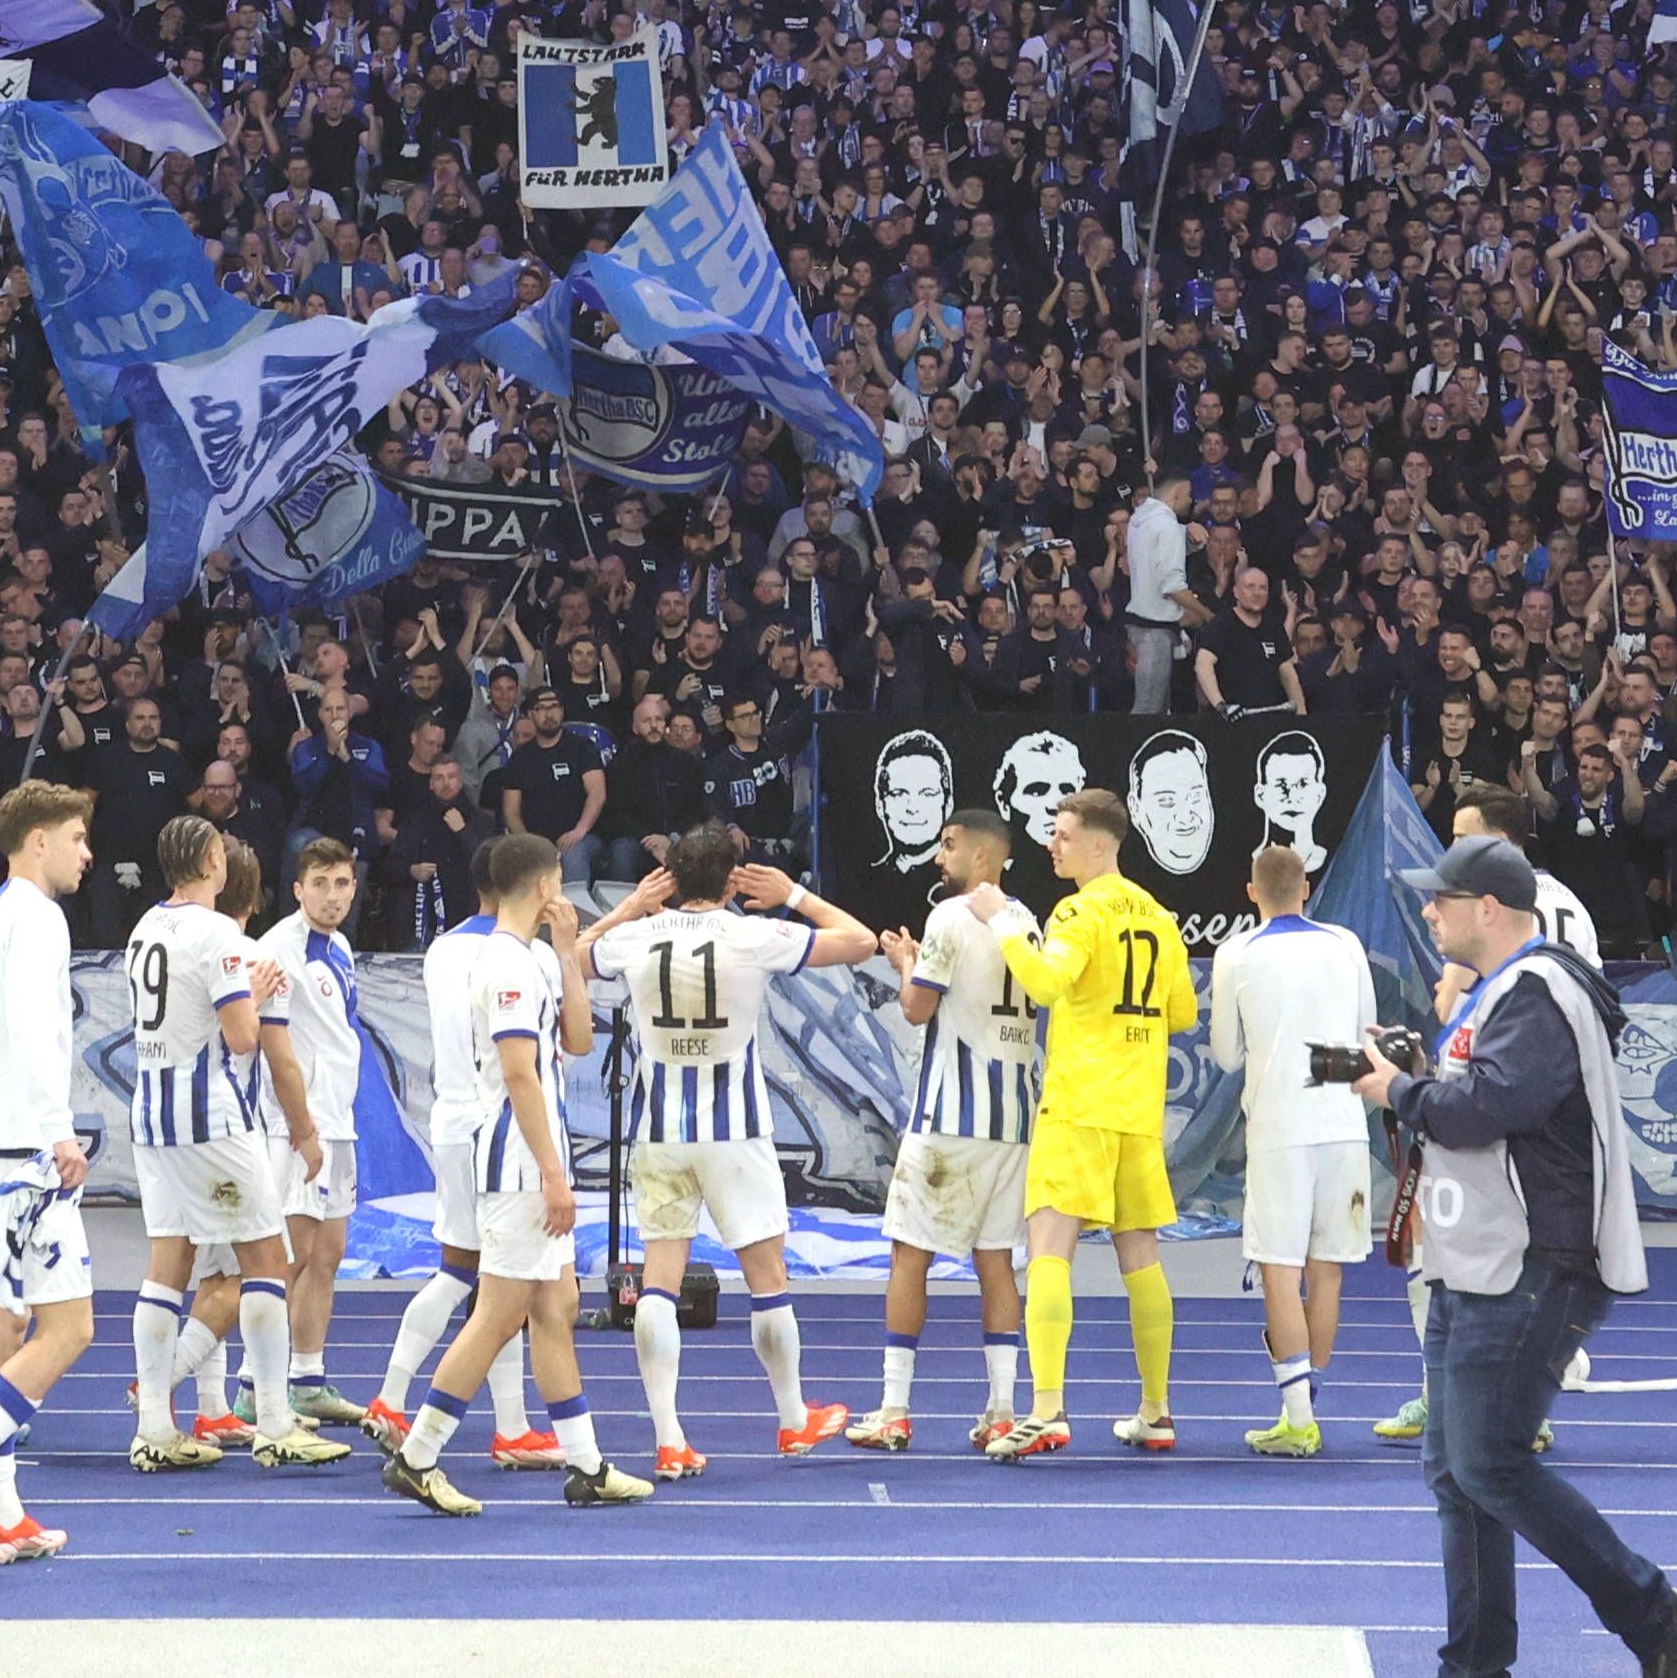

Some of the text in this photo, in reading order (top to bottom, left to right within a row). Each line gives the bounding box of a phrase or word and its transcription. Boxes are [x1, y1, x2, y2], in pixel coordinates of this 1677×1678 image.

[522, 41, 647, 64] LAUTSTARK
[573, 165, 665, 187] HERTHA
[1112, 927, 1162, 1018] 12
[649, 939, 729, 1030] 11
[671, 1037, 710, 1057] REESE
